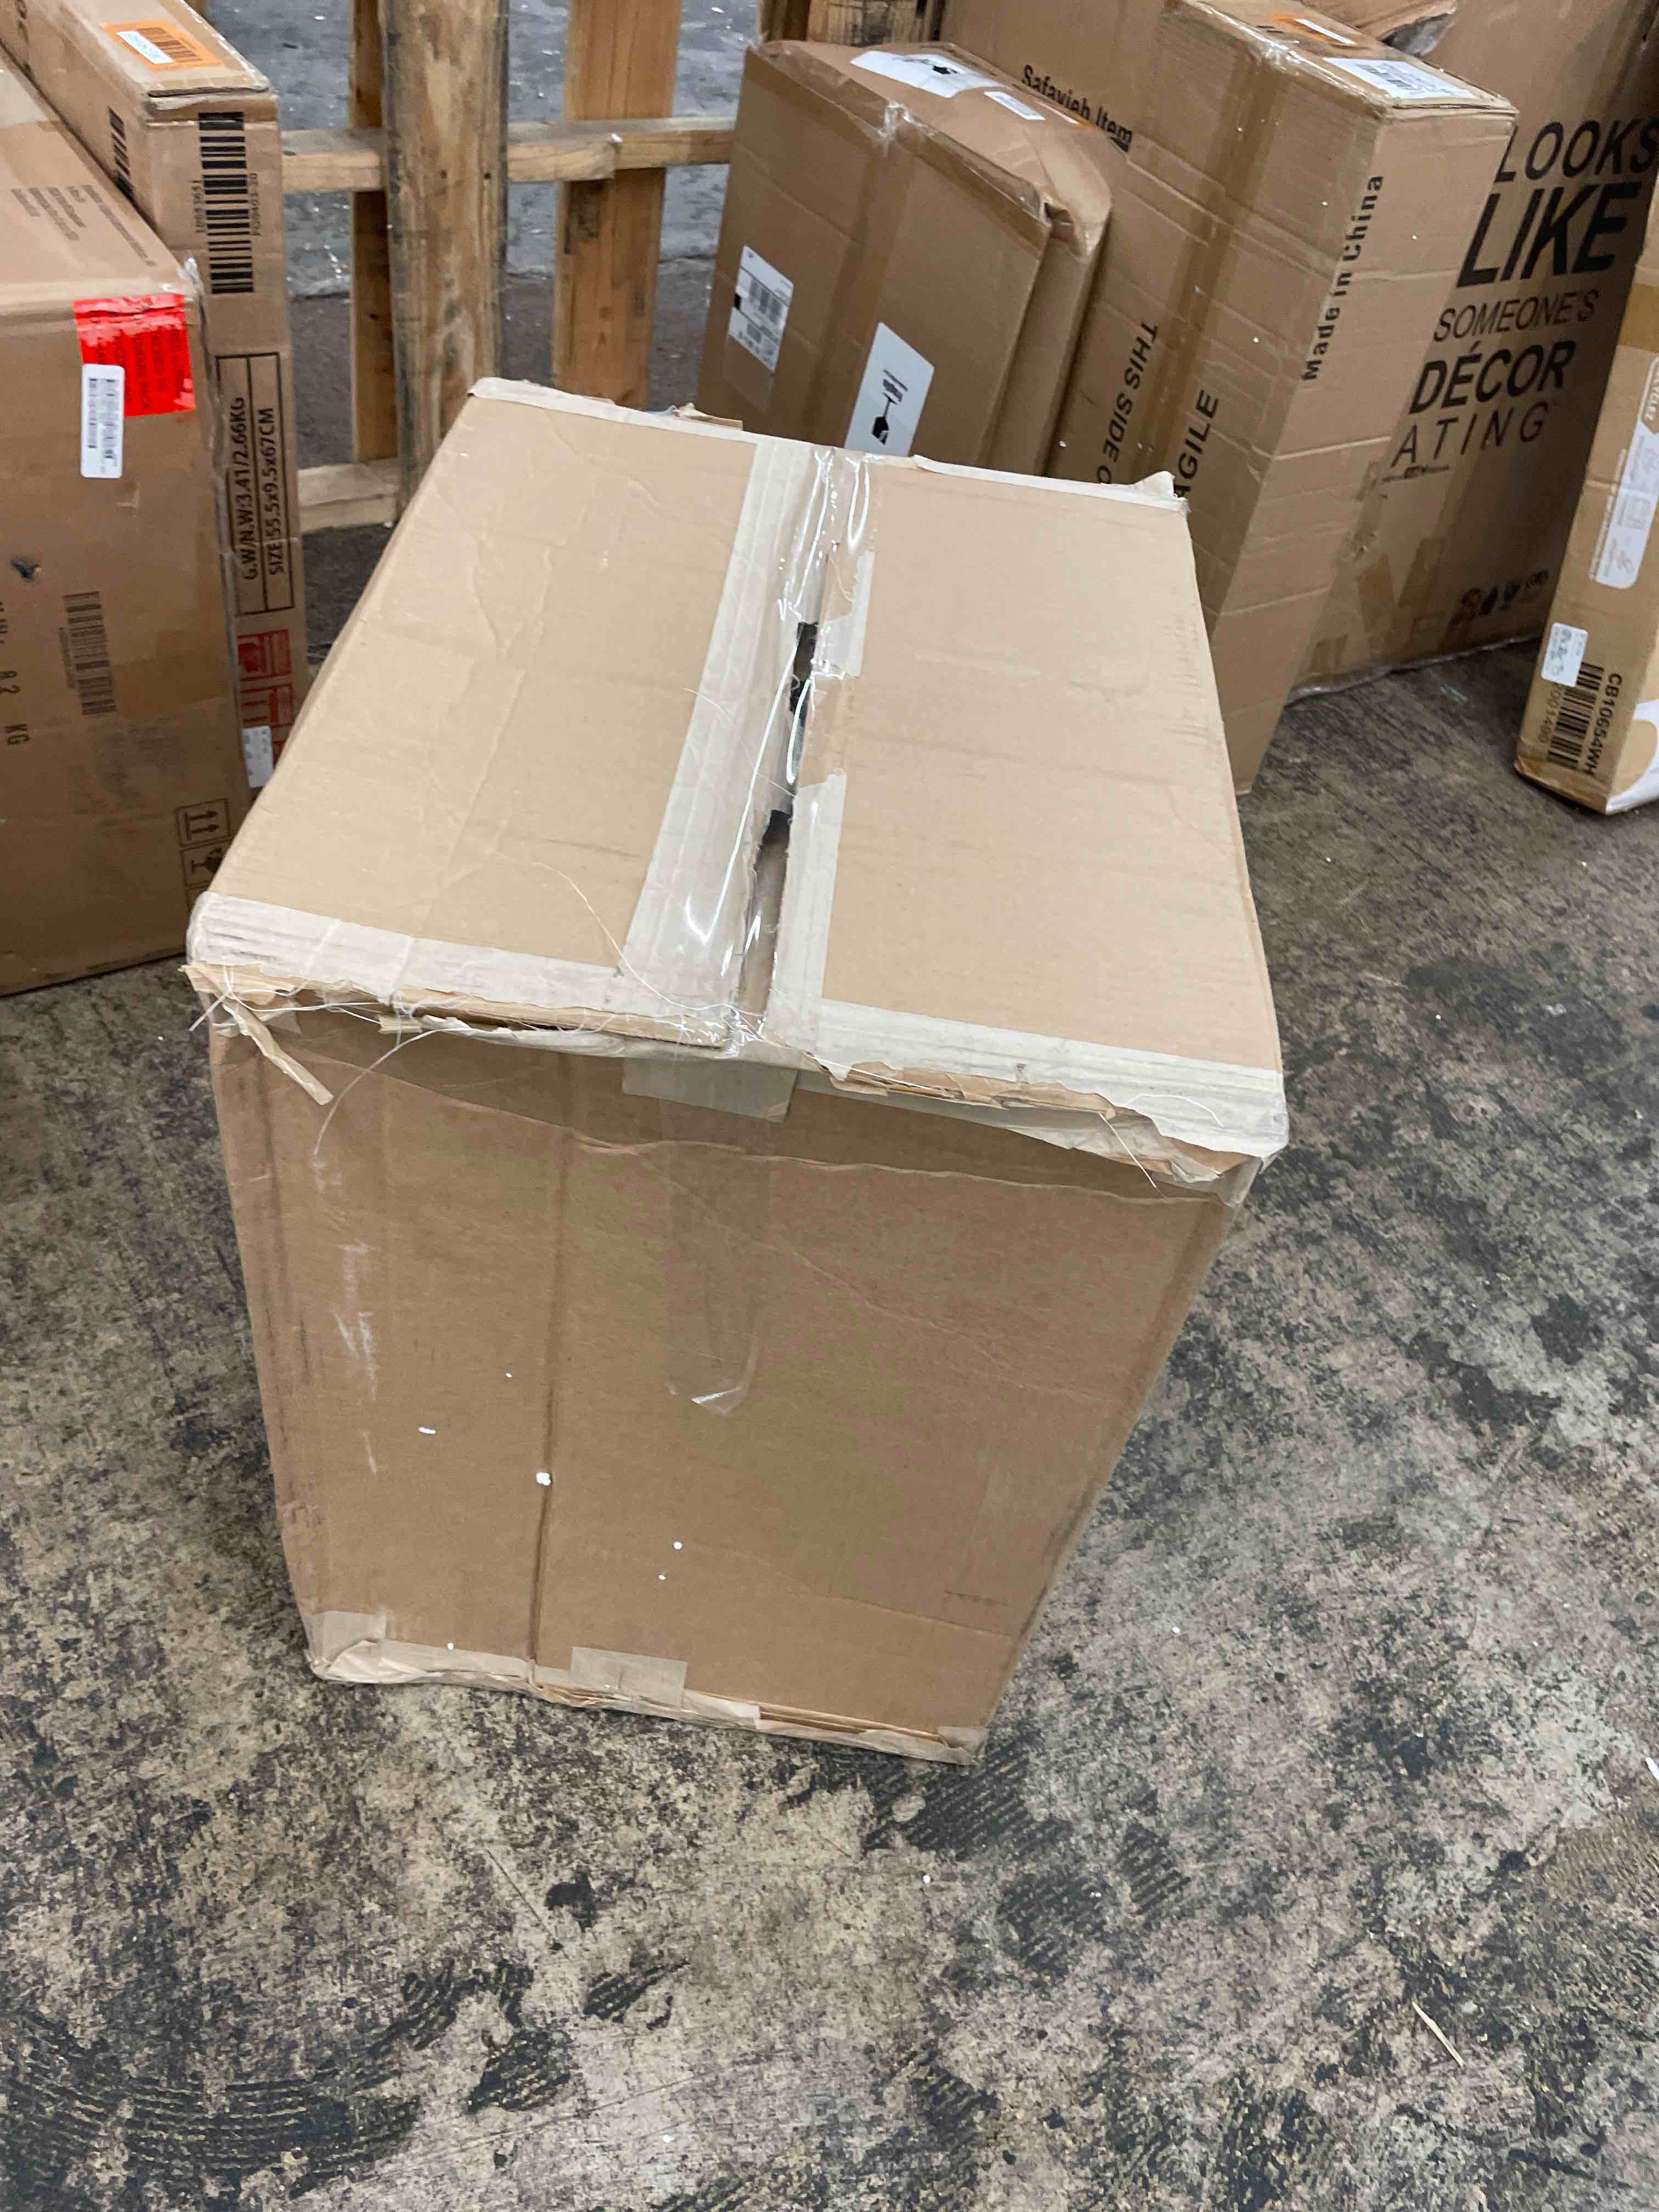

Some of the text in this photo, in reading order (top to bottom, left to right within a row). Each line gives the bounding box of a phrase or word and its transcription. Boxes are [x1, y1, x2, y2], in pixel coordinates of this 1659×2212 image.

[1494, 119, 1659, 183] LOOKS
[1457, 181, 1643, 289] LIKE
[1300, 176, 1383, 380] Made in China
[1124, 321, 1158, 390] THIS
[1409, 340, 1576, 414] DÉCOR
[1103, 393, 1133, 463] SIDE
[4, 724, 30, 746] KG
